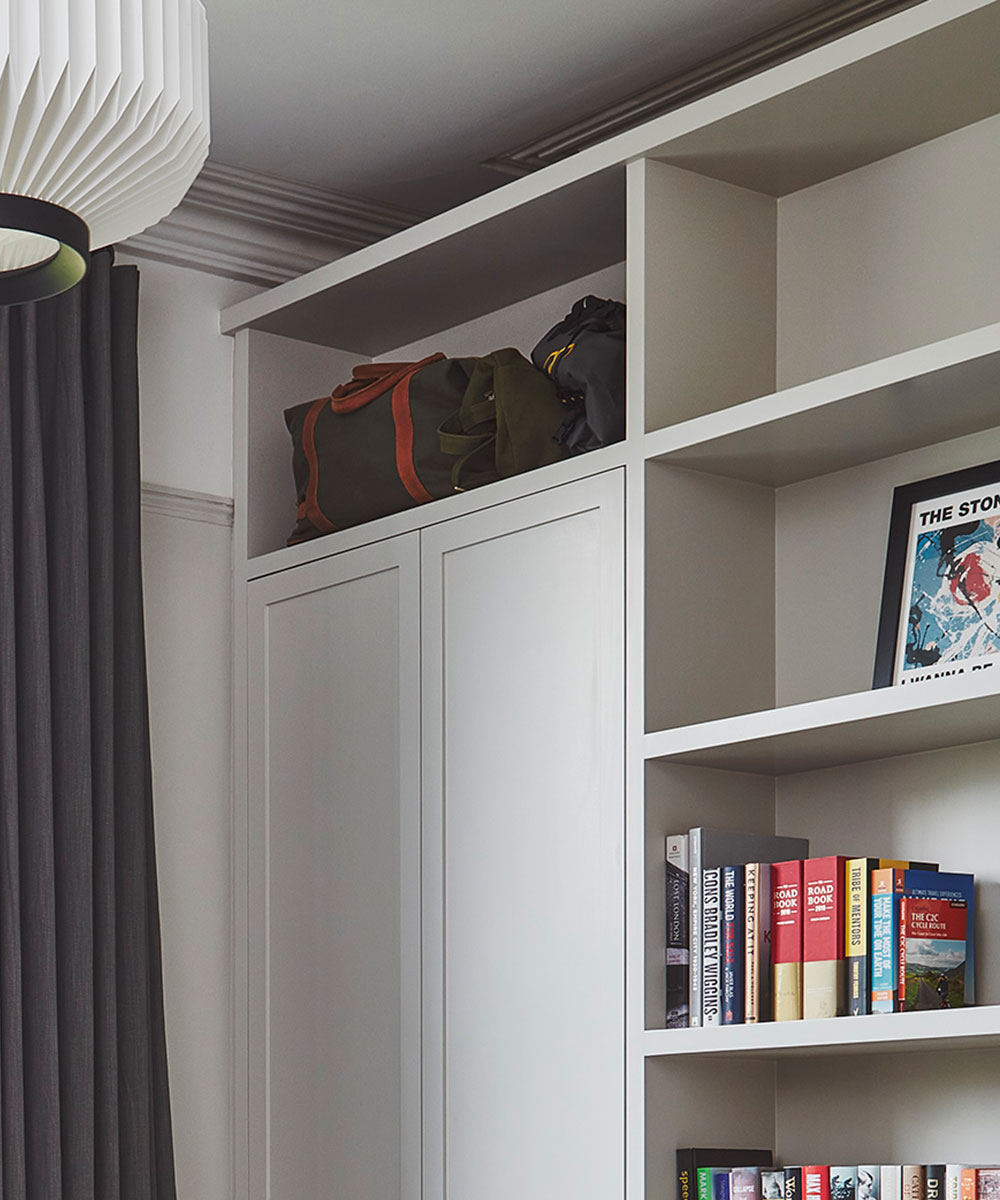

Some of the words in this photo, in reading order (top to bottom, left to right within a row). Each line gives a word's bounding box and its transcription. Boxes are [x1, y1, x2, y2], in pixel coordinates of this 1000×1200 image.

[920, 505, 954, 527] THE
[724, 871, 735, 888] THE
[851, 867, 861, 892] TRIBE
[747, 869, 755, 923] KEEPING
[774, 889, 798, 899] ROAD
[808, 885, 834, 896] ROAD
[808, 895, 833, 905] BOOK
[853, 894, 860, 902] OF
[725, 889, 735, 921] WORLD
[774, 899, 798, 909] BOOK
[874, 897, 883, 919] YOUR
[882, 897, 891, 919] MAKE
[672, 902, 681, 941] LONDON
[851, 905, 861, 946] MENTORS
[911, 912, 925, 921] THE
[926, 913, 940, 922] C2C
[704, 908, 718, 960] BRADLEY
[724, 923, 735, 941] FOR
[747, 928, 755, 944] AT
[874, 920, 883, 939] TIME
[882, 923, 891, 933] THE
[724, 942, 735, 964] SALE
[747, 945, 755, 956] IT
[874, 939, 883, 951] ON
[874, 952, 883, 978] EARTH
[882, 960, 891, 970] OF
[704, 963, 718, 1016] WIGGINS
[699, 1172, 708, 1200] MARK
[806, 1174, 821, 1193] MAX
